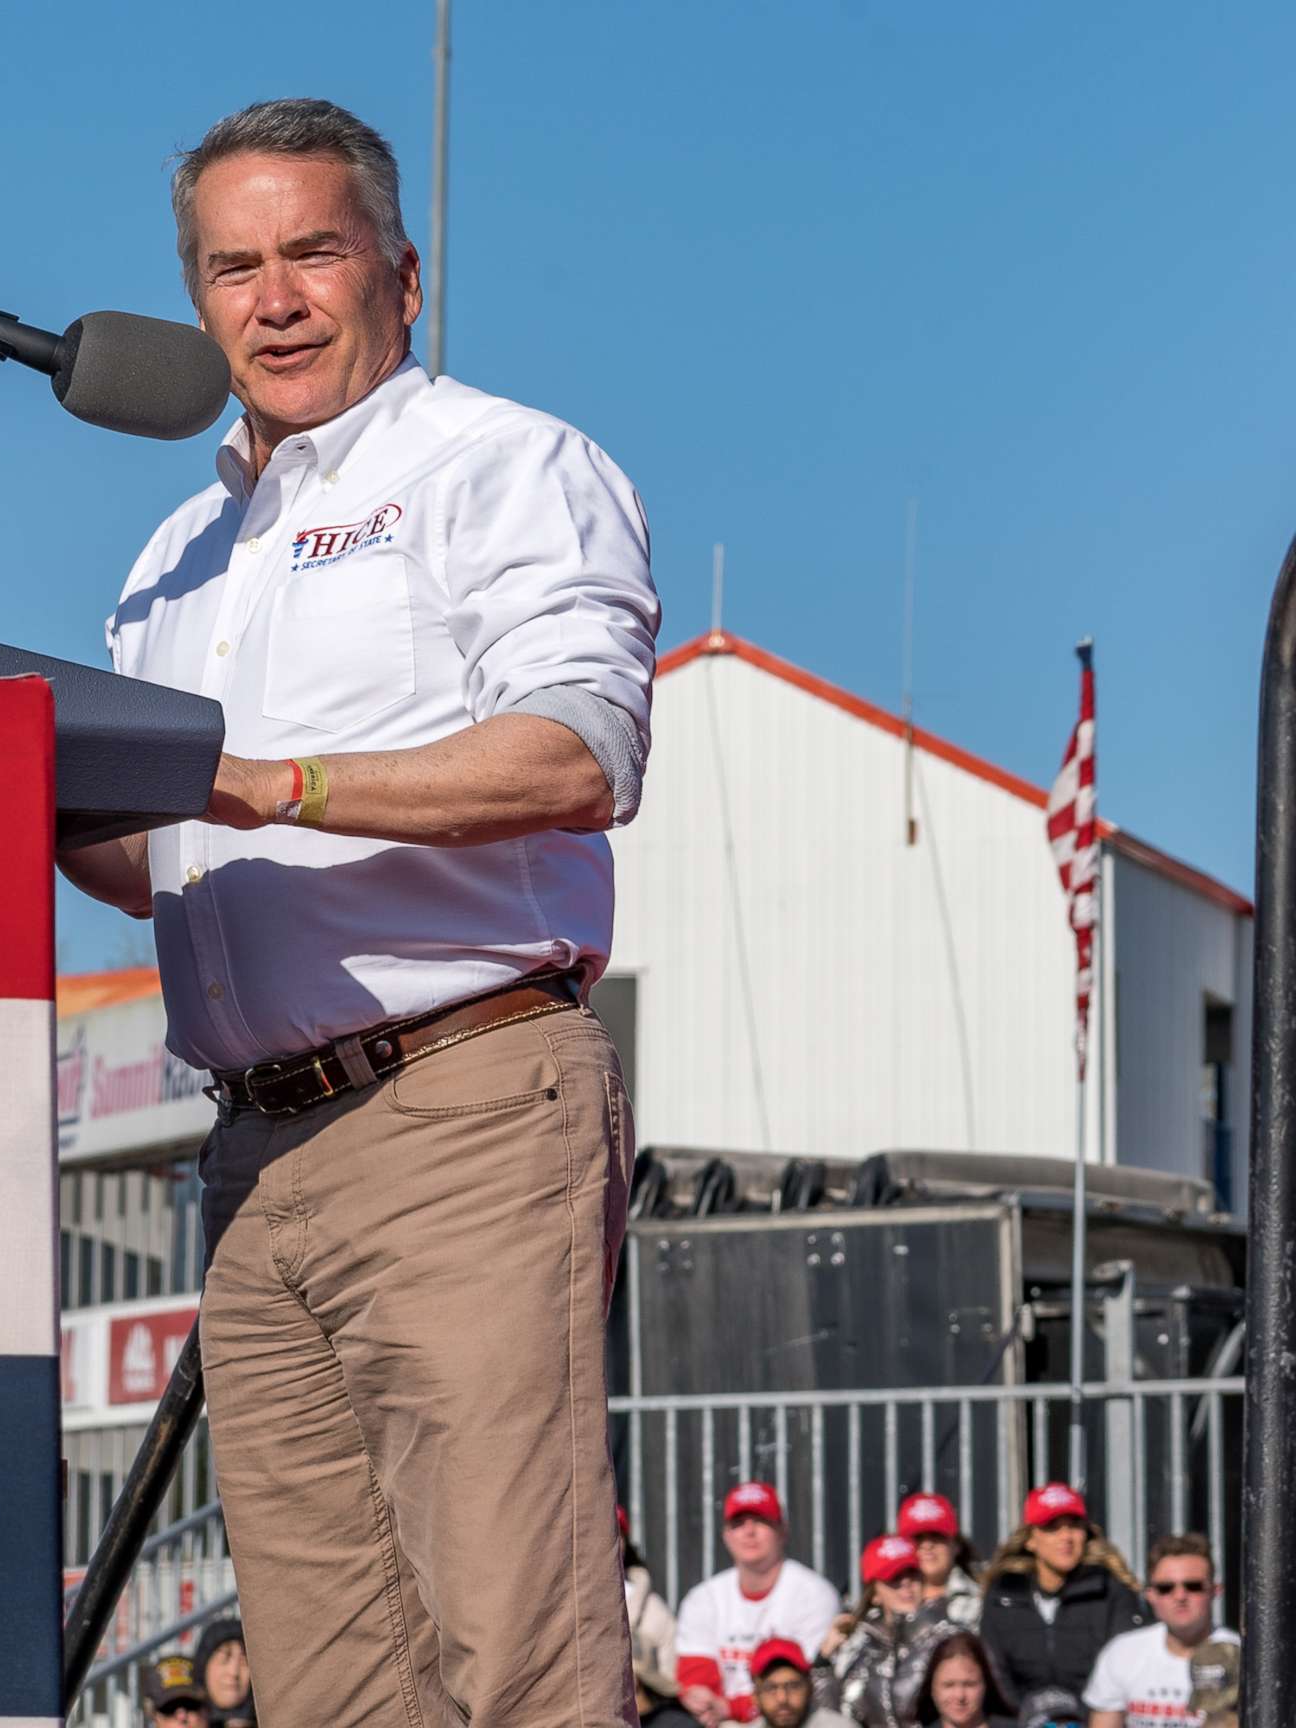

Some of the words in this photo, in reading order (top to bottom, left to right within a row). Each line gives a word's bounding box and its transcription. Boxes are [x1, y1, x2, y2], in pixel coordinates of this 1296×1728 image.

[301, 554, 345, 570] SECRETARY
[359, 535, 382, 550] STATE
[307, 508, 388, 558] HICE
